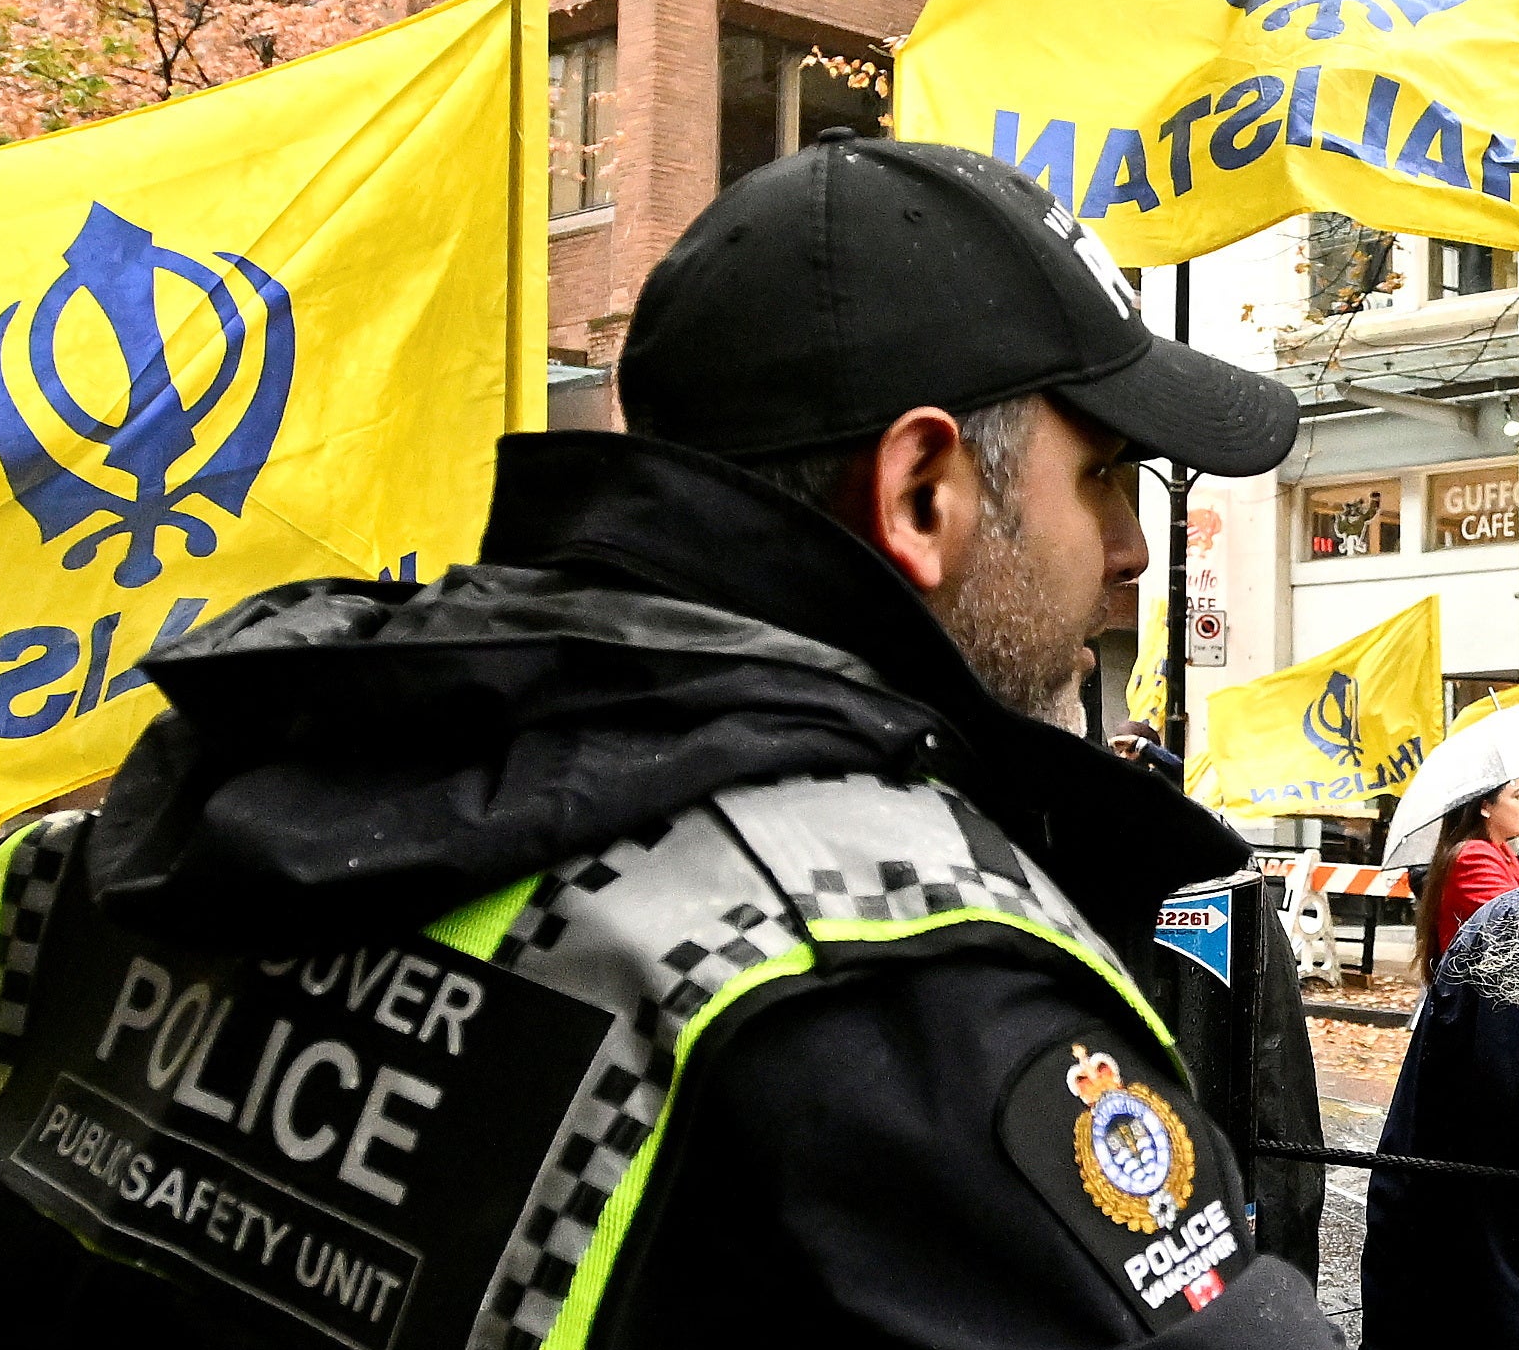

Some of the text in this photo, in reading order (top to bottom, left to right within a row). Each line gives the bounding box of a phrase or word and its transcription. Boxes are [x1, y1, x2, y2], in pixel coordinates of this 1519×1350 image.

[1461, 506, 1515, 540] CAFÉ
[1186, 597, 1216, 610] AFE
[1187, 569, 1218, 592] uffo
[95, 955, 444, 1206] POLICE
[37, 1104, 404, 1324] PUBLIC SAFETY UNIT
[1124, 1200, 1231, 1291] POLICE
